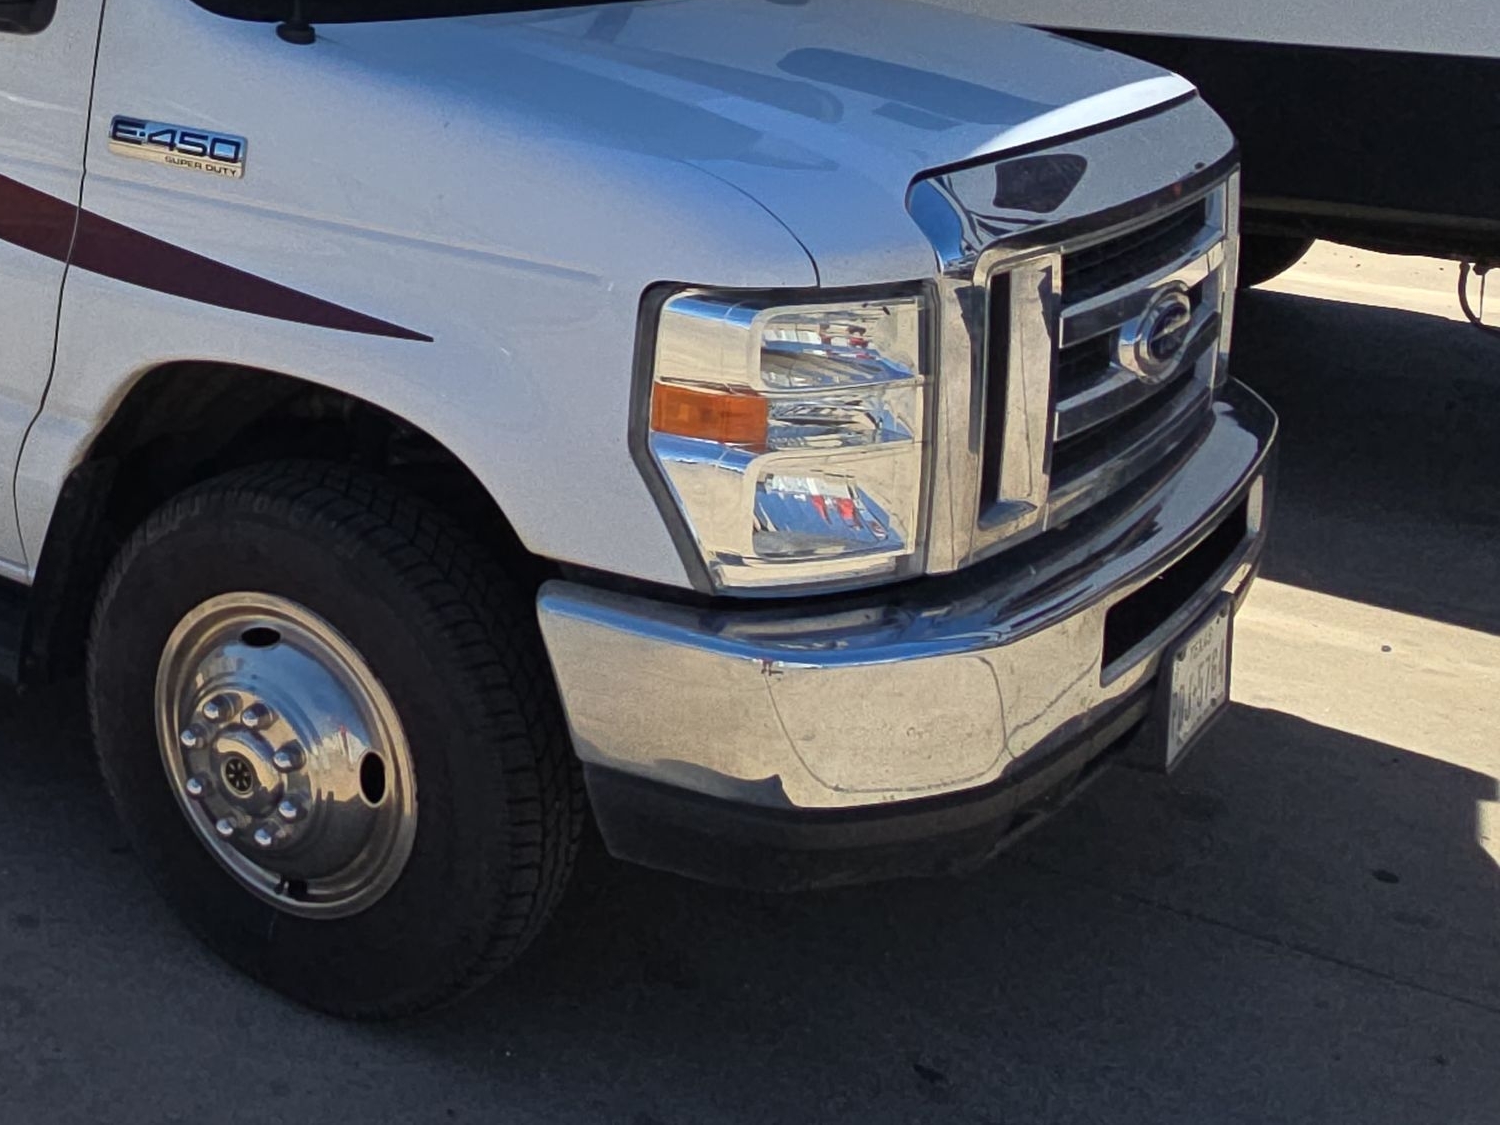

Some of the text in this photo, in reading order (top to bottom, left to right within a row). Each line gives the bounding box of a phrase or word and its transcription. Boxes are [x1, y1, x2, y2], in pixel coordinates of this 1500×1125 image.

[111, 118, 242, 164] E-450
[165, 155, 238, 177] SUPER DUTY
